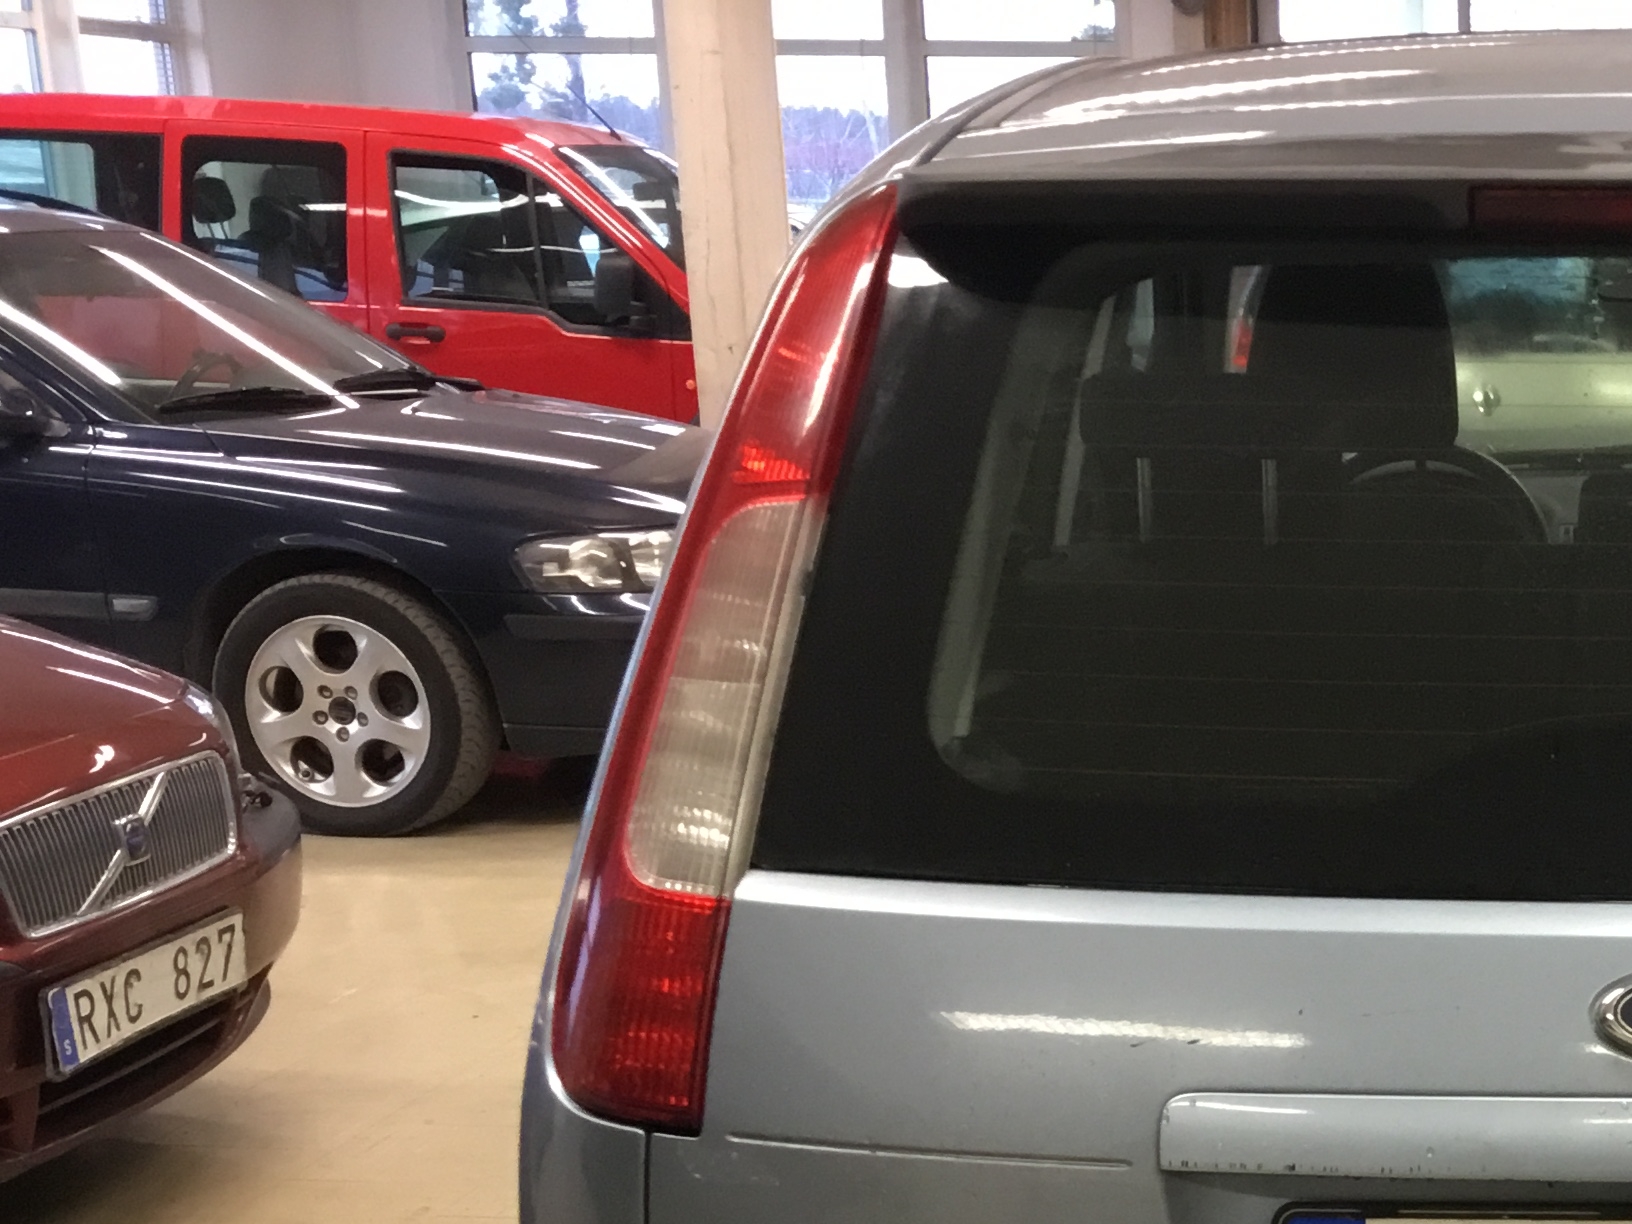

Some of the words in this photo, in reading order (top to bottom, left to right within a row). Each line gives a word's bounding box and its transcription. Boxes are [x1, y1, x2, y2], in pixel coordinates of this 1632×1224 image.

[73, 968, 144, 1050] RXC
[173, 923, 236, 1001] 827
[63, 1038, 73, 1056] S
